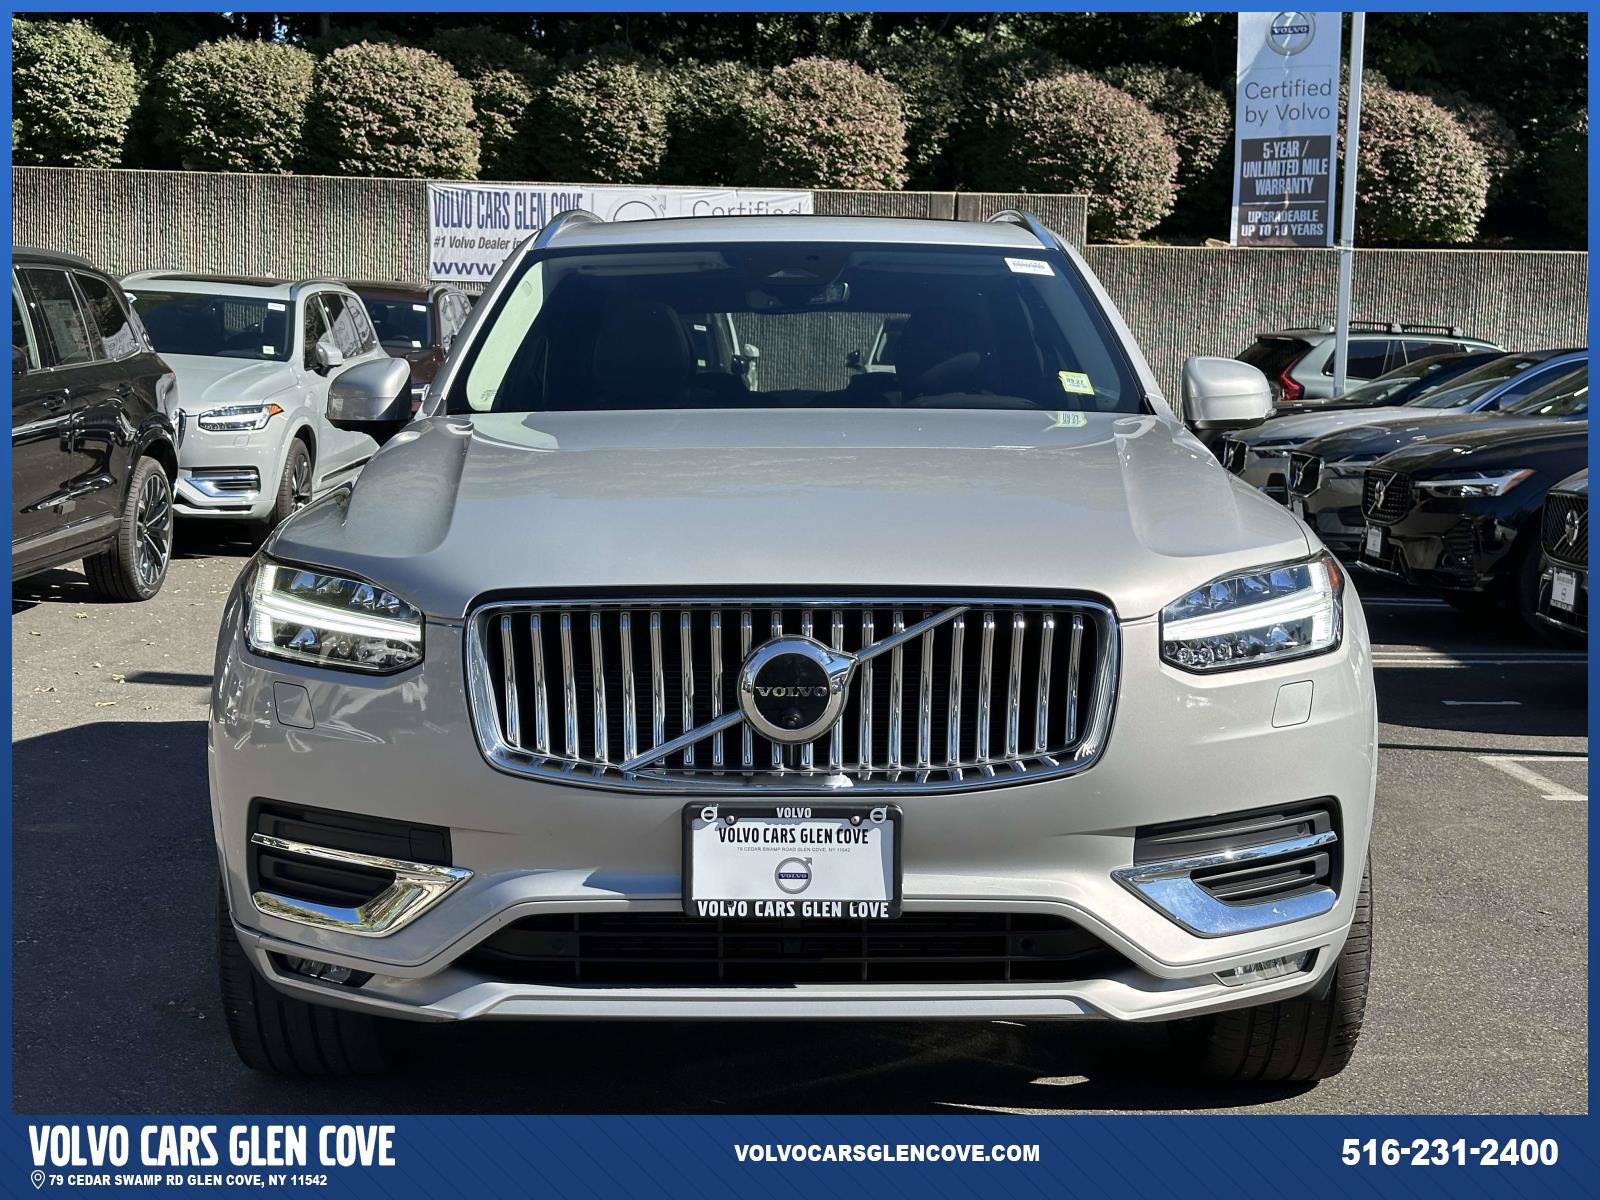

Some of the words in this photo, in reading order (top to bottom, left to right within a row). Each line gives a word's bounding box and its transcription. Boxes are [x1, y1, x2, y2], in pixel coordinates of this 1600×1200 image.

[1271, 26, 1309, 34] VOLVO
[1245, 79, 1332, 100] Certified
[1245, 105, 1269, 127] by
[1275, 102, 1330, 121] Volvo
[1263, 140, 1300, 159] 5-YEAR
[1242, 159, 1299, 178] UNLIMITED
[1302, 158, 1328, 176] MILE
[1255, 177, 1314, 196] WARRANTY
[433, 189, 473, 229] VOLVO
[477, 190, 510, 230] CARS
[515, 191, 546, 230] GLEN
[1247, 209, 1319, 224] UPGRADEABLE
[1241, 223, 1256, 237] UP
[1259, 223, 1272, 237] TO
[1275, 223, 1288, 237] 10
[1290, 222, 1324, 237] YEARS
[434, 236, 446, 248] #1
[449, 236, 476, 249] Volvo
[478, 236, 511, 250] Dealer
[755, 686, 828, 697] VOLVO
[776, 807, 812, 818] VOLVO
[718, 827, 760, 844] VOLVO
[763, 827, 796, 844] CARS
[800, 827, 833, 844] GLEN
[836, 828, 869, 845] COVE
[698, 901, 747, 917] VOLVO
[754, 901, 795, 917] CARS
[802, 901, 842, 917] GLEN
[849, 902, 889, 918] COVE
